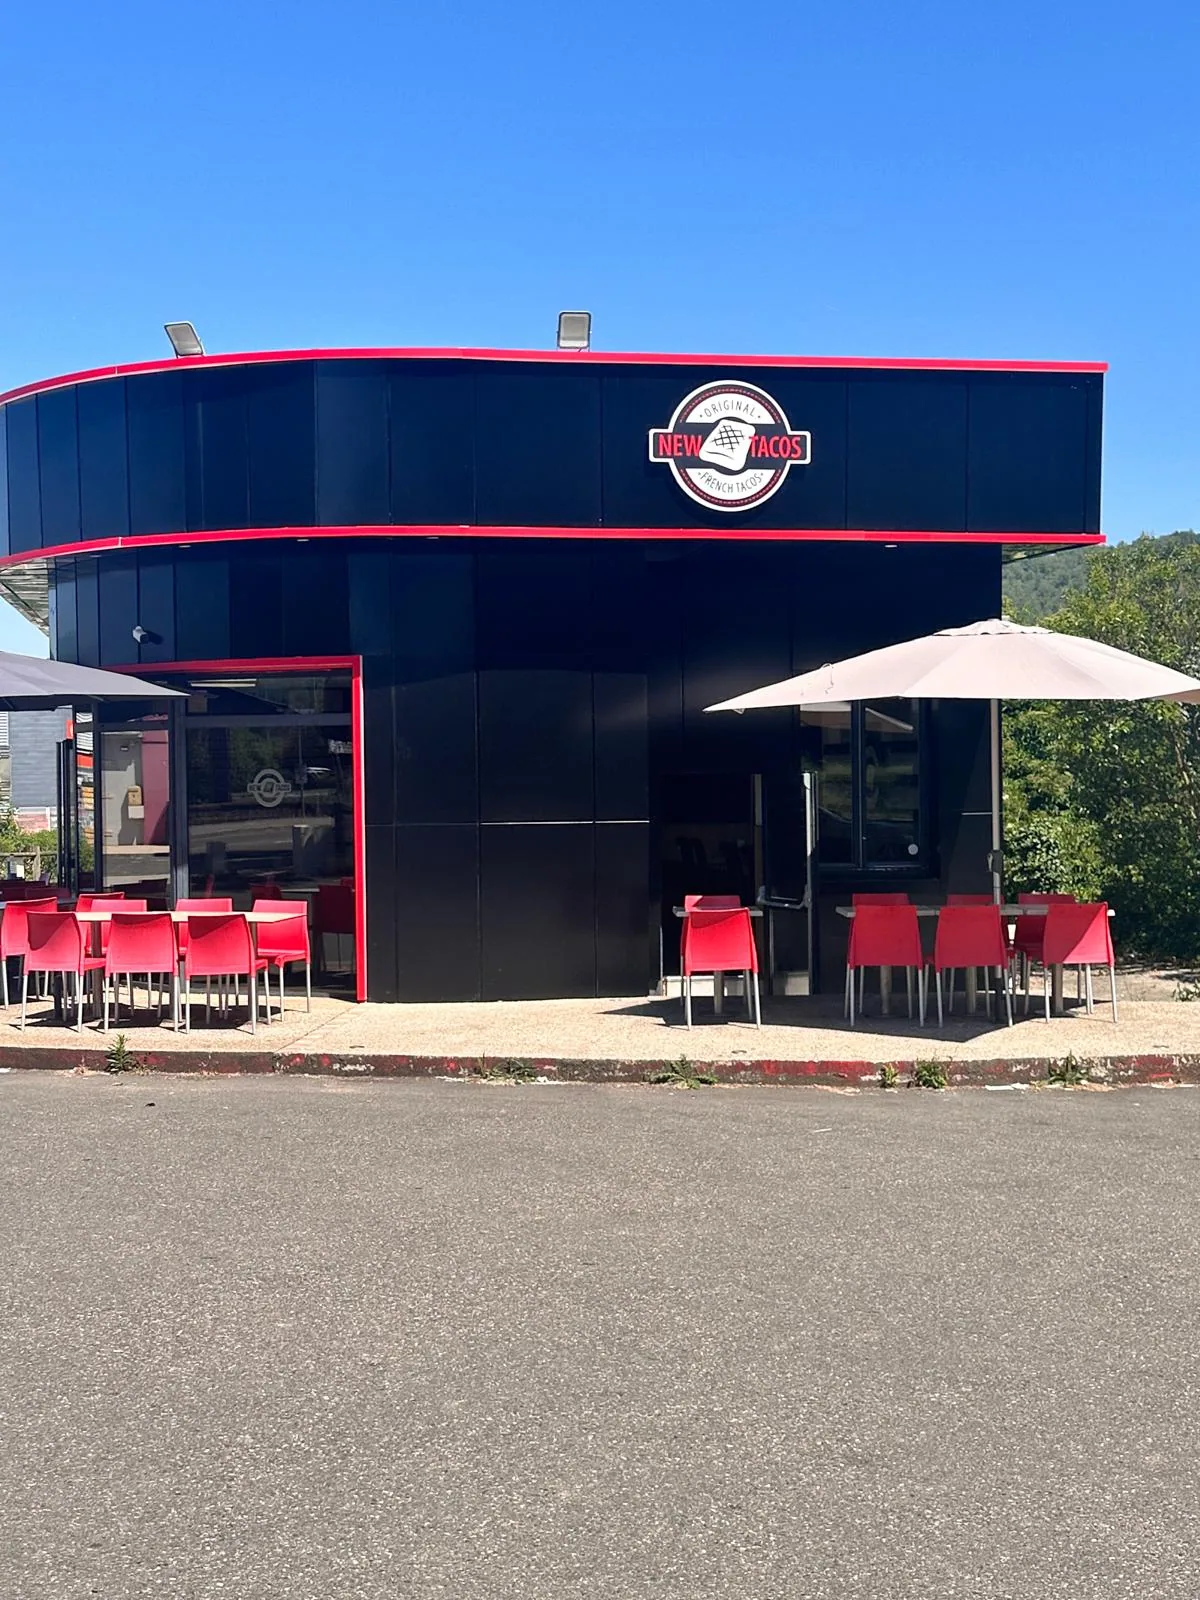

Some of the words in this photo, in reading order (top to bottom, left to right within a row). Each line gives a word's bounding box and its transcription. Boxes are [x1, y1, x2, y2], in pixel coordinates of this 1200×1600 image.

[704, 400, 755, 418] ORIGINAL
[658, 434, 703, 457] NEW
[749, 436, 801, 458] TACOS
[700, 472, 733, 493] FRENCH
[736, 474, 762, 493] TACOS
